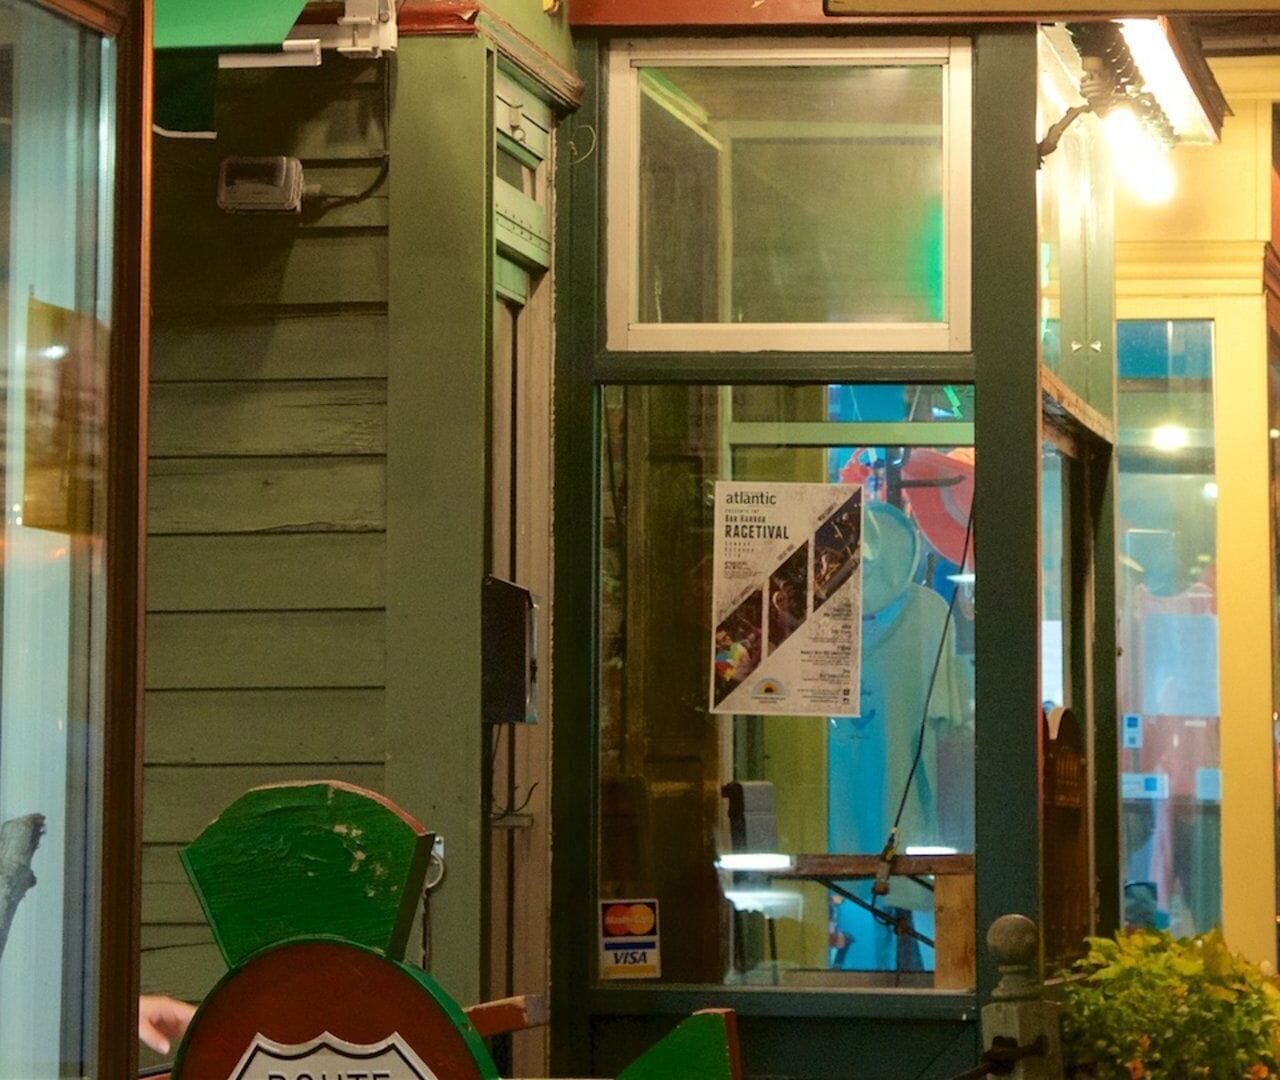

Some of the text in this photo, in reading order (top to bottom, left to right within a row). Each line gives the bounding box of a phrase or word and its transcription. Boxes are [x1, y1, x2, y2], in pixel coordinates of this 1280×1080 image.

[726, 491, 777, 505] atlantic
[725, 524, 789, 539] RACETIVAL
[613, 951, 648, 965] VISA
